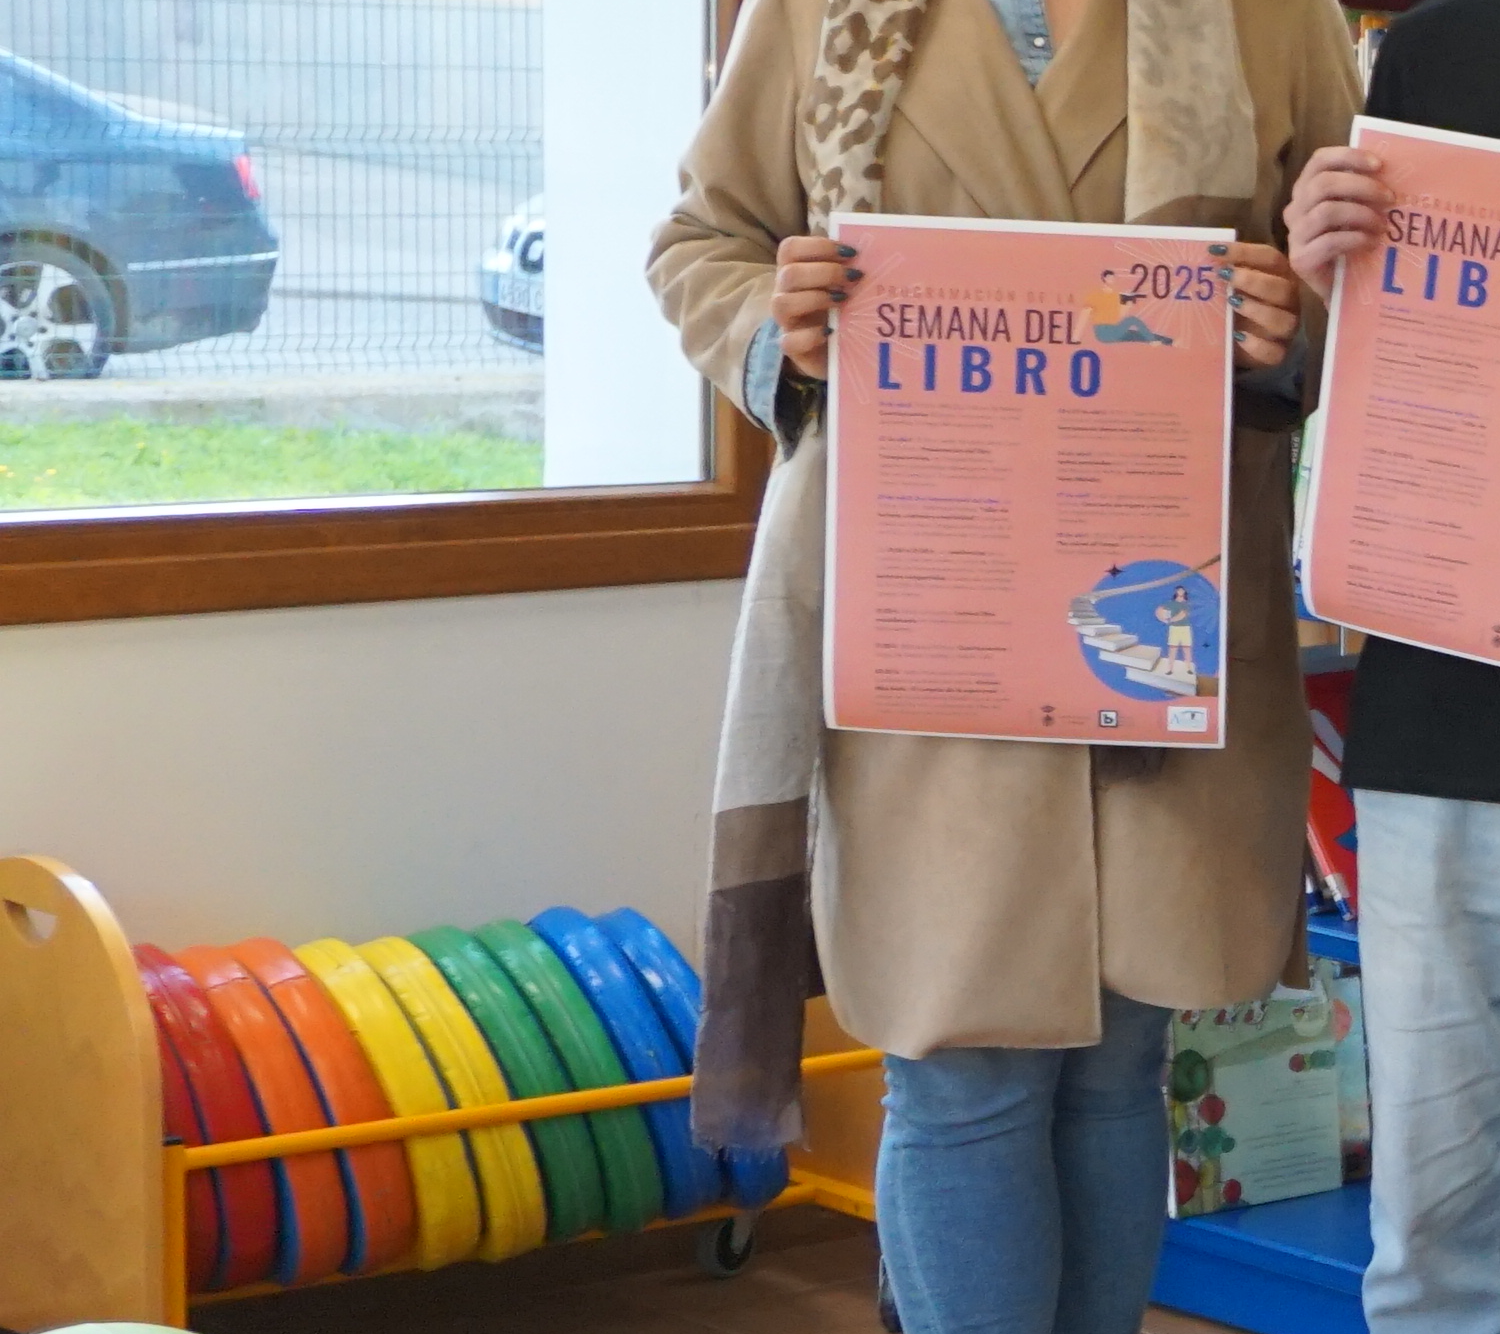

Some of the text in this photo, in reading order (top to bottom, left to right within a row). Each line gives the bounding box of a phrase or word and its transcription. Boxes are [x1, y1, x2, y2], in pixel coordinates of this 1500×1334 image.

[1129, 263, 1215, 303] 2025
[877, 302, 1082, 346] SEMANA DEL
[877, 341, 1102, 398] LIBRO
